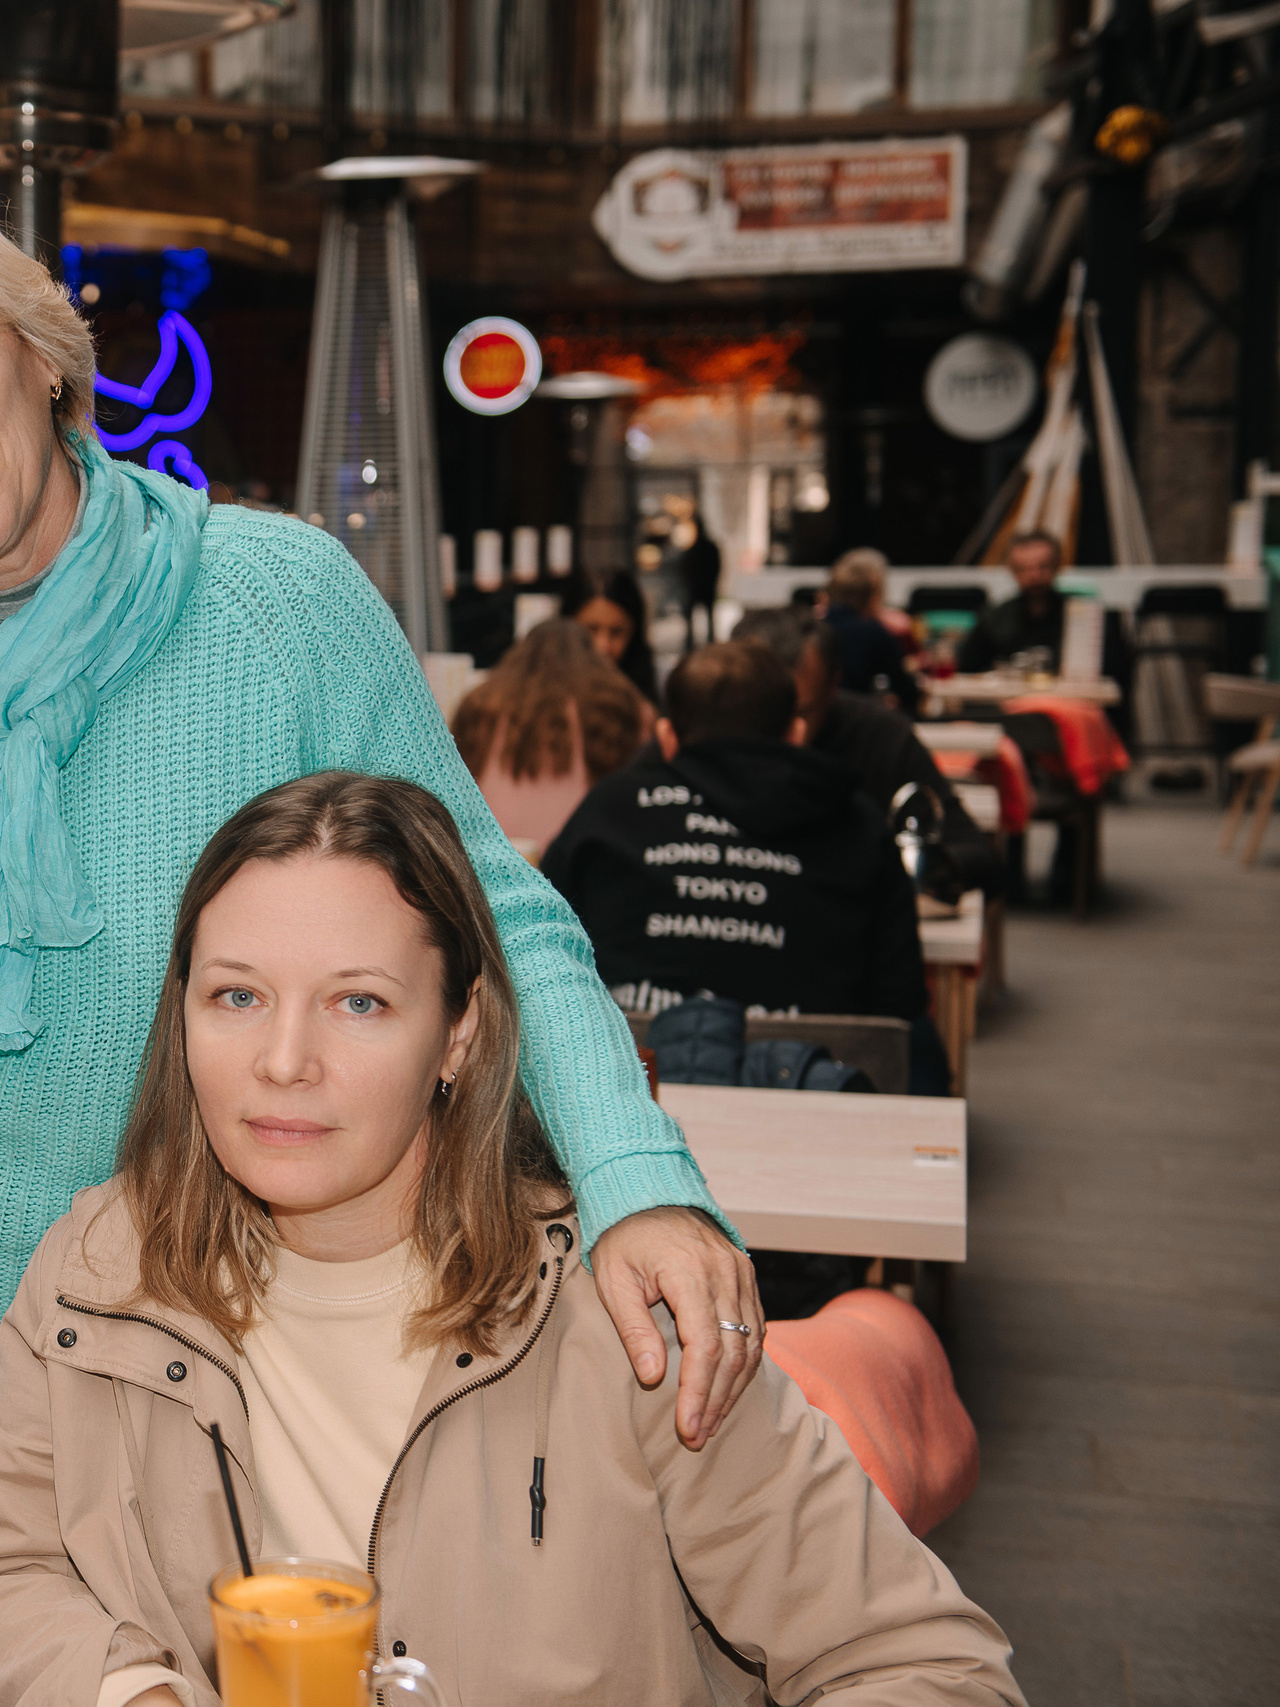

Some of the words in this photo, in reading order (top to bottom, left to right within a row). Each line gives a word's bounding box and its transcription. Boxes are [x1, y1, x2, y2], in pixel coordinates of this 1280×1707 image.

[637, 785, 691, 808] LOS
[643, 843, 721, 866] HONG
[725, 845, 802, 875] KONG
[674, 875, 768, 905] TOKYO
[645, 913, 785, 947] SHANGHAI
